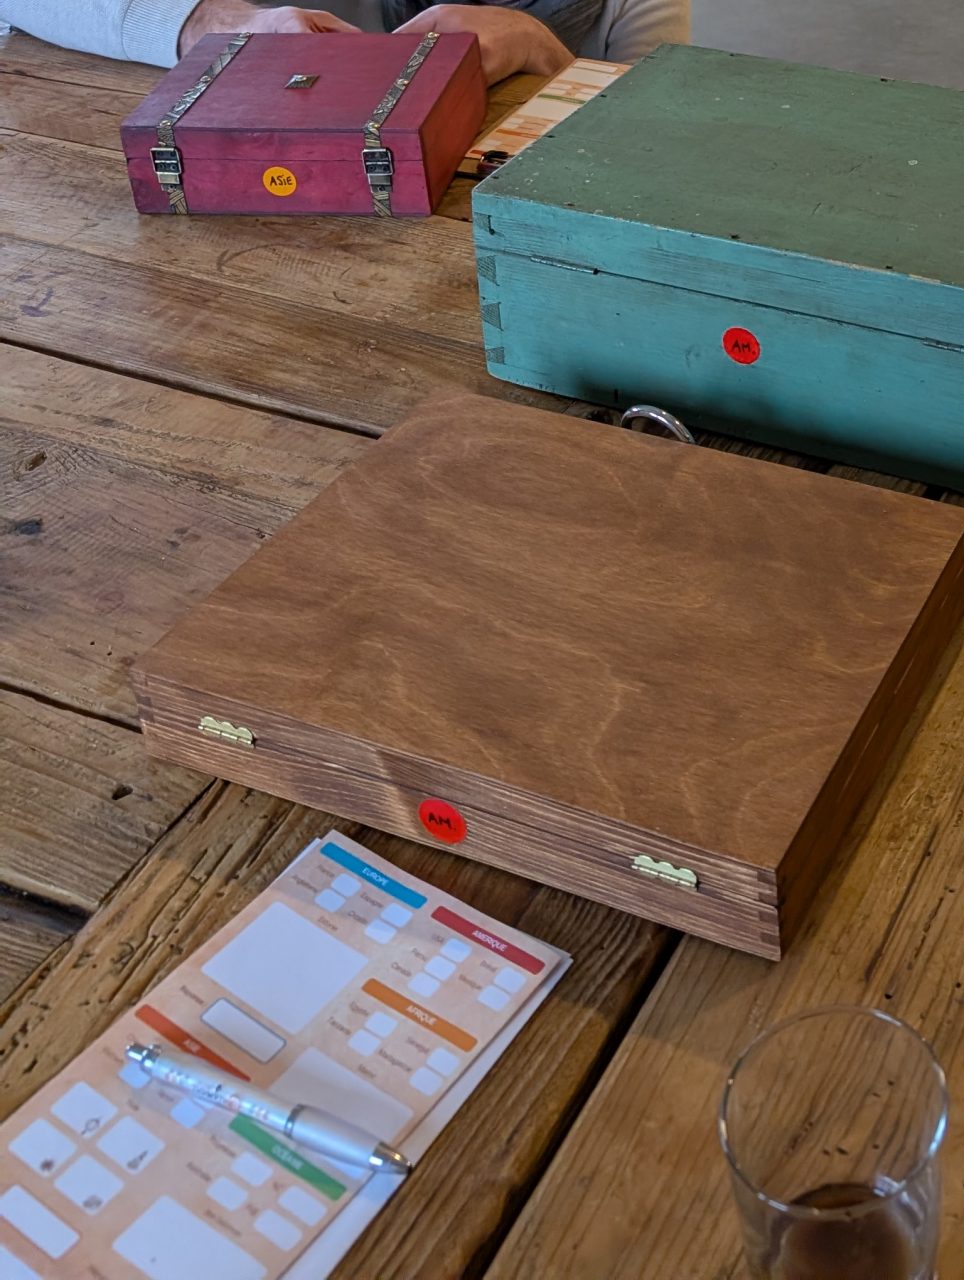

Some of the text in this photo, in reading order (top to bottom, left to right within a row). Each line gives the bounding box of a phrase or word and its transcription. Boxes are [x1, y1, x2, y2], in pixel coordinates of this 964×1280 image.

[362, 867, 389, 886] EUROPE
[471, 930, 509, 952] AMERIQUE
[406, 1005, 437, 1026] AFRIQUE
